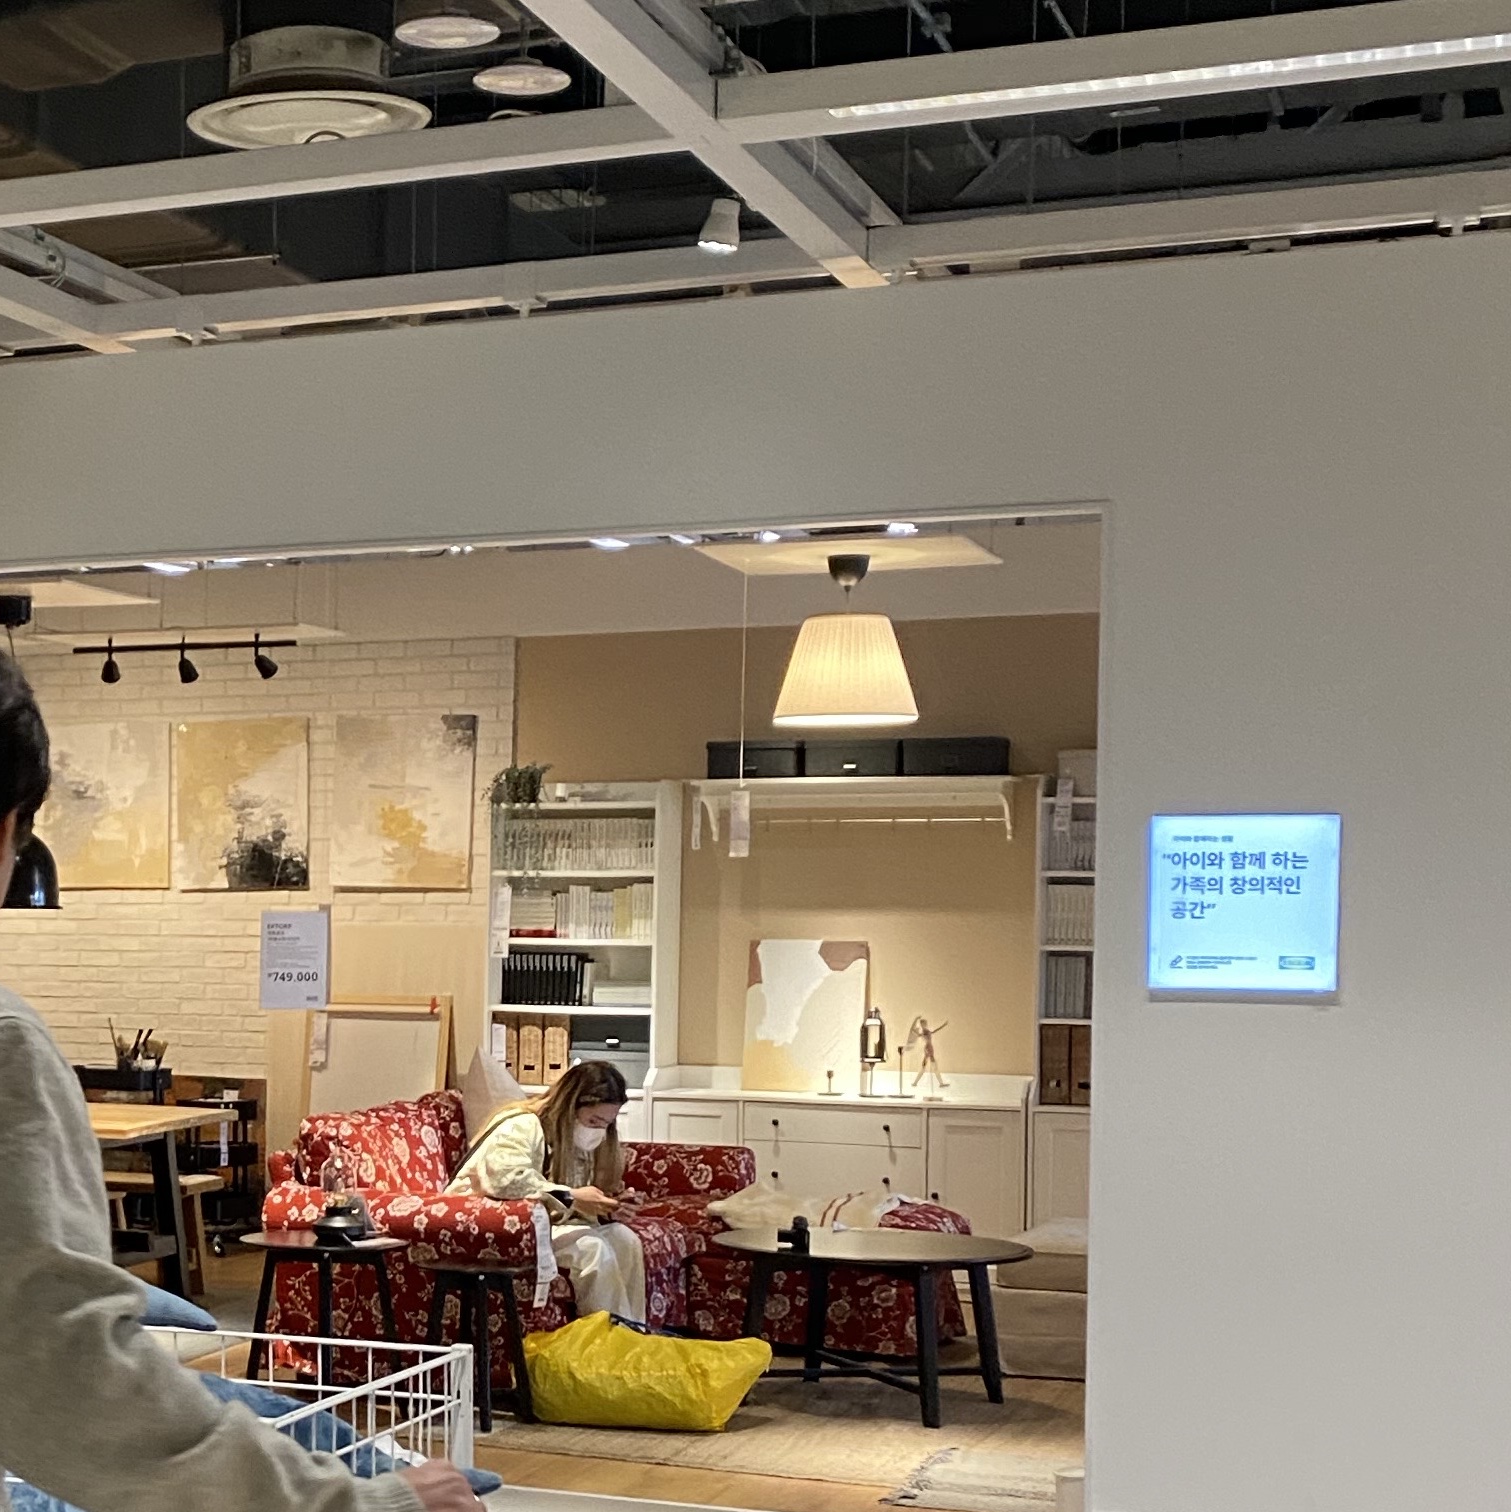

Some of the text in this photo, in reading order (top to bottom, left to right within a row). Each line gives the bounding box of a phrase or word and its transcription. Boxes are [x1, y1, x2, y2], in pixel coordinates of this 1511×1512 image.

[1230, 851, 1266, 870] 함께
[1271, 851, 1309, 870] 하는
[1171, 876, 1301, 895] 가족의 창의적인
